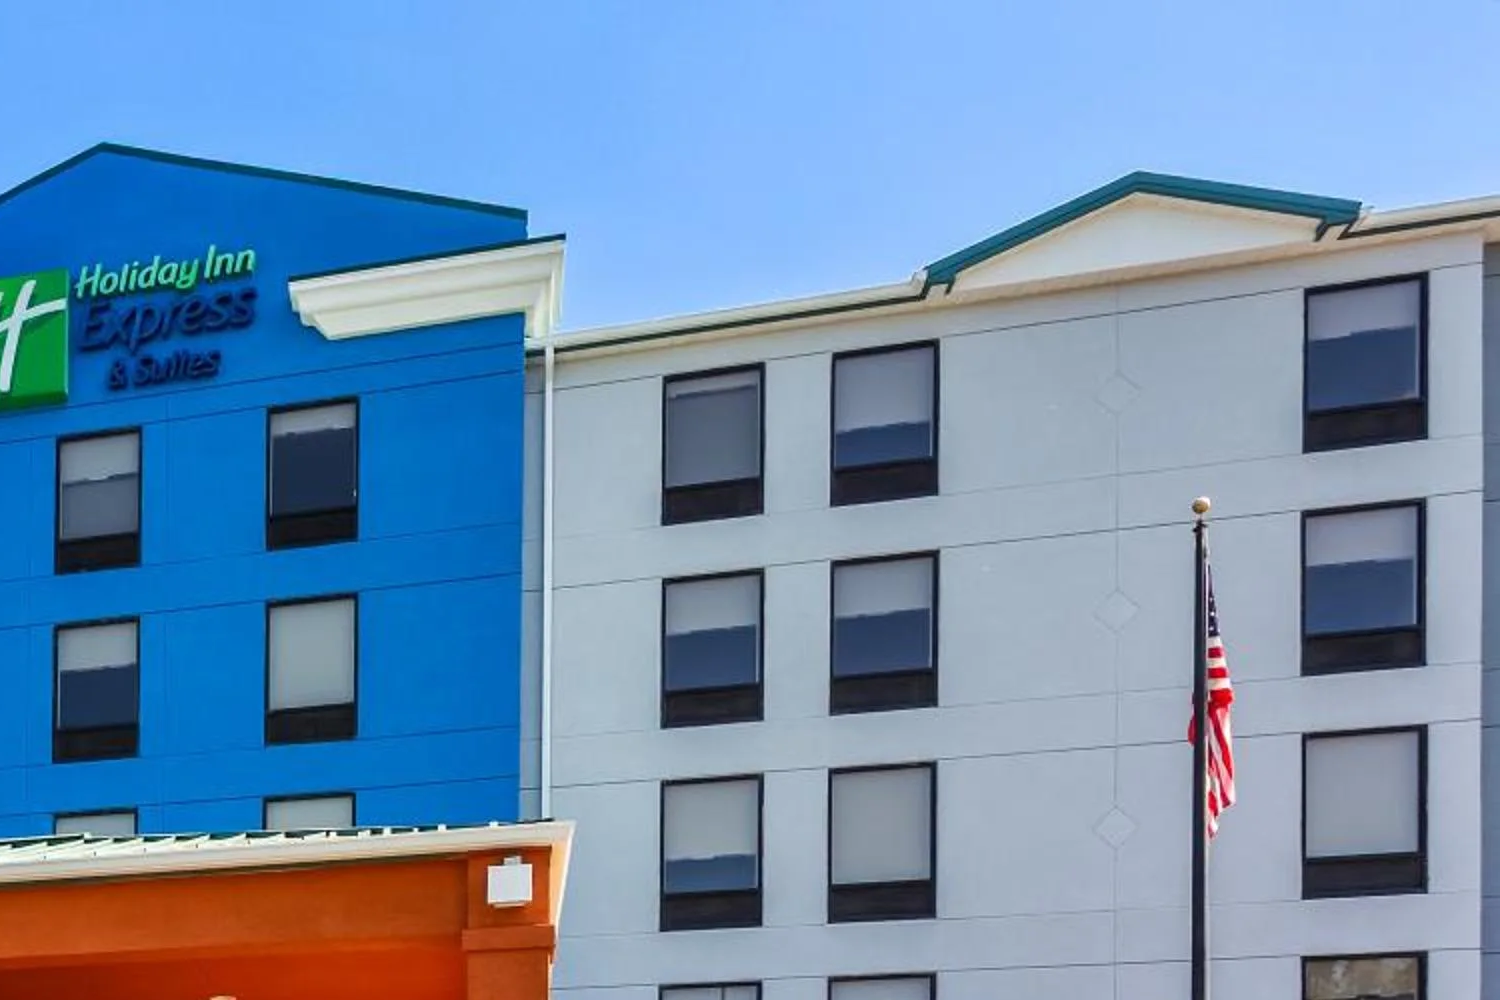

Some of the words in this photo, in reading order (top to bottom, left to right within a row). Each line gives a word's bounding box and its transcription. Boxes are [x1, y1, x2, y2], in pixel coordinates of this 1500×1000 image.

[74, 255, 198, 297] Holiday
[203, 245, 257, 278] Inn
[77, 289, 257, 352] Express
[107, 362, 128, 391] &
[133, 350, 220, 387] Suites
